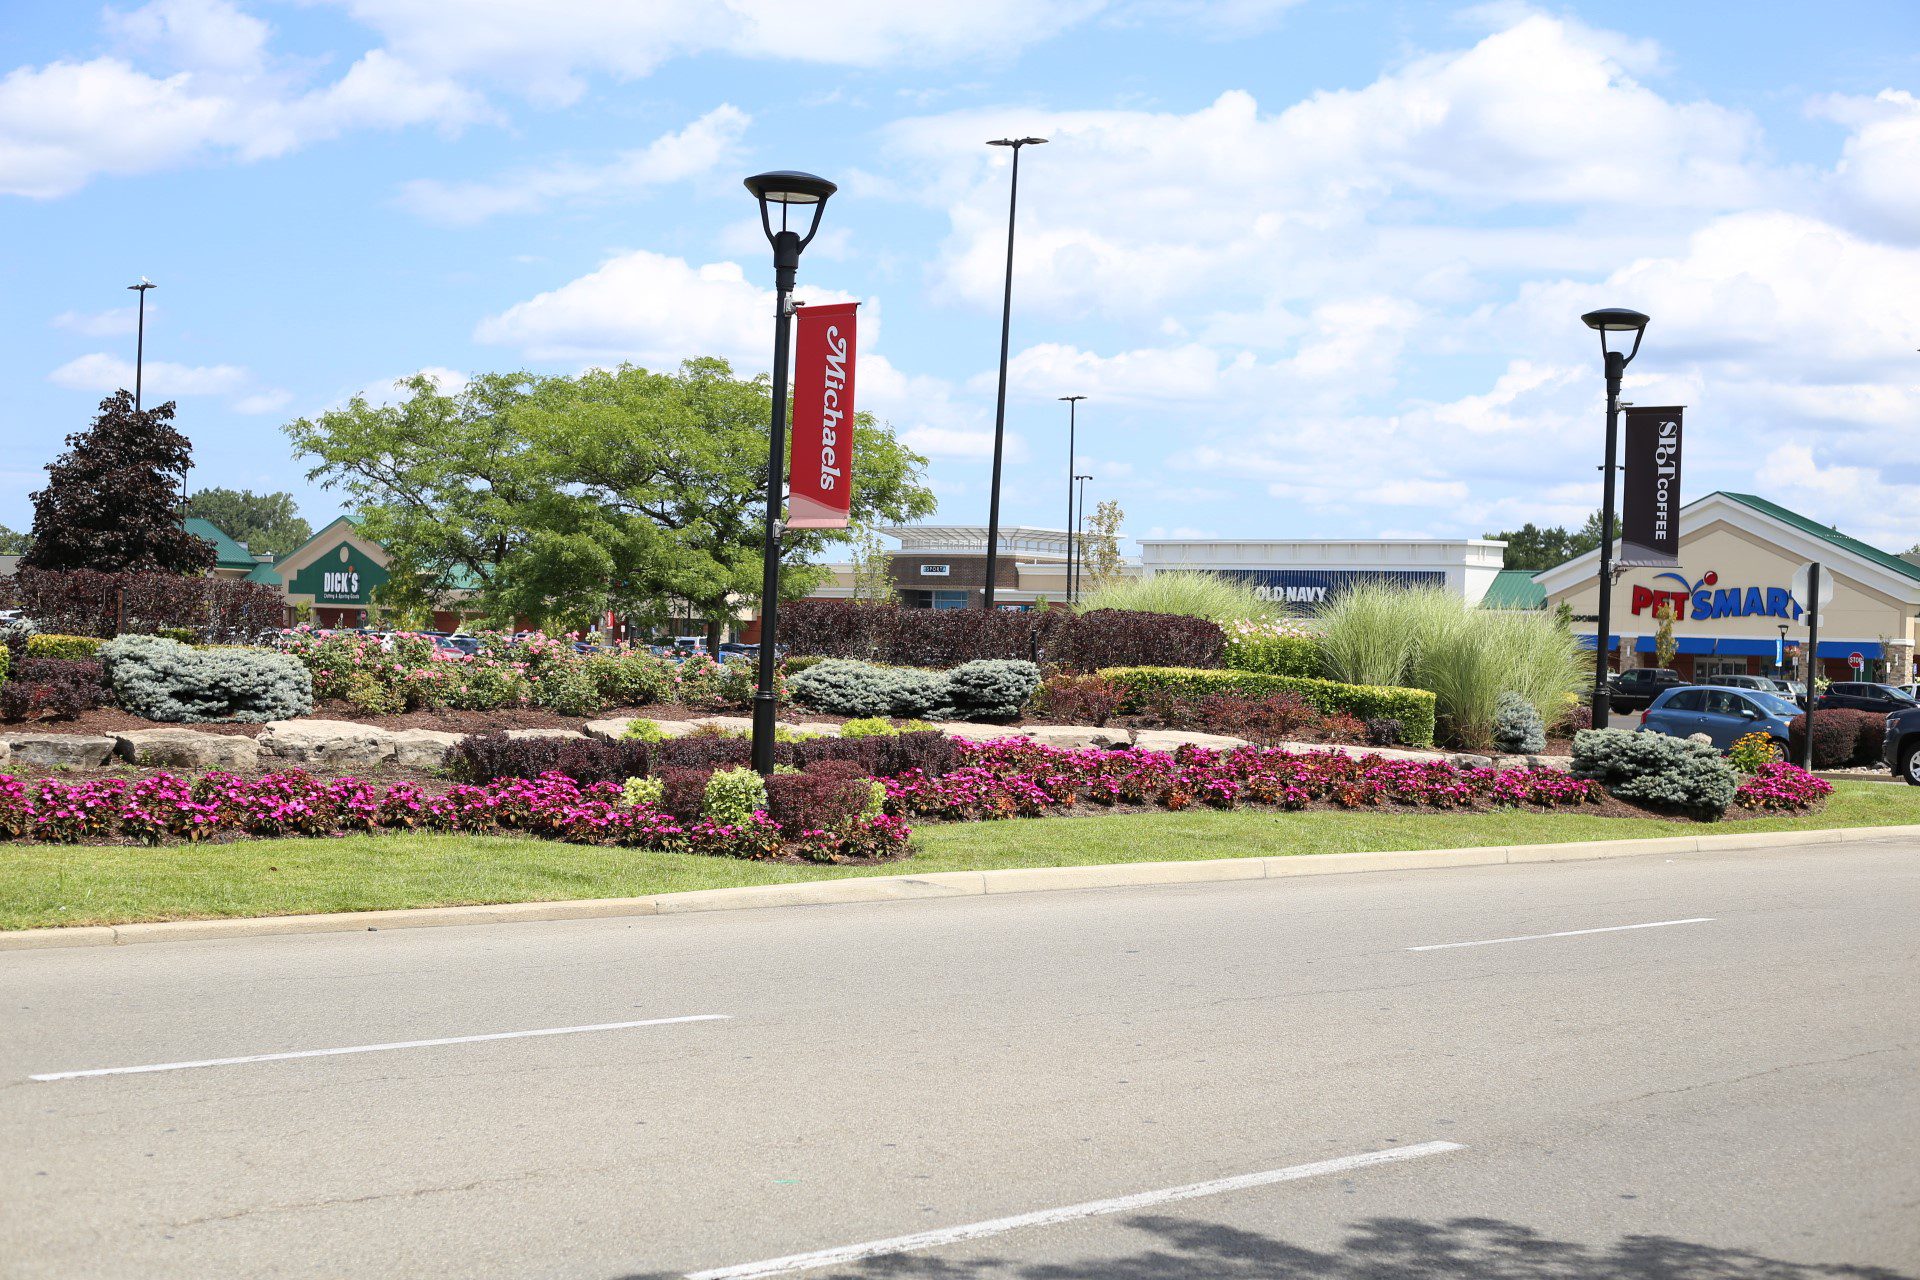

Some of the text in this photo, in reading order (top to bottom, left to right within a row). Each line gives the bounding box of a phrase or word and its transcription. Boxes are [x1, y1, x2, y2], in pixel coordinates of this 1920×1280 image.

[820, 325, 847, 491] Michaels
[1655, 478, 1669, 540] COFFEE
[323, 571, 359, 593] DICK'S
[1255, 586, 1327, 602] OLD NAVY
